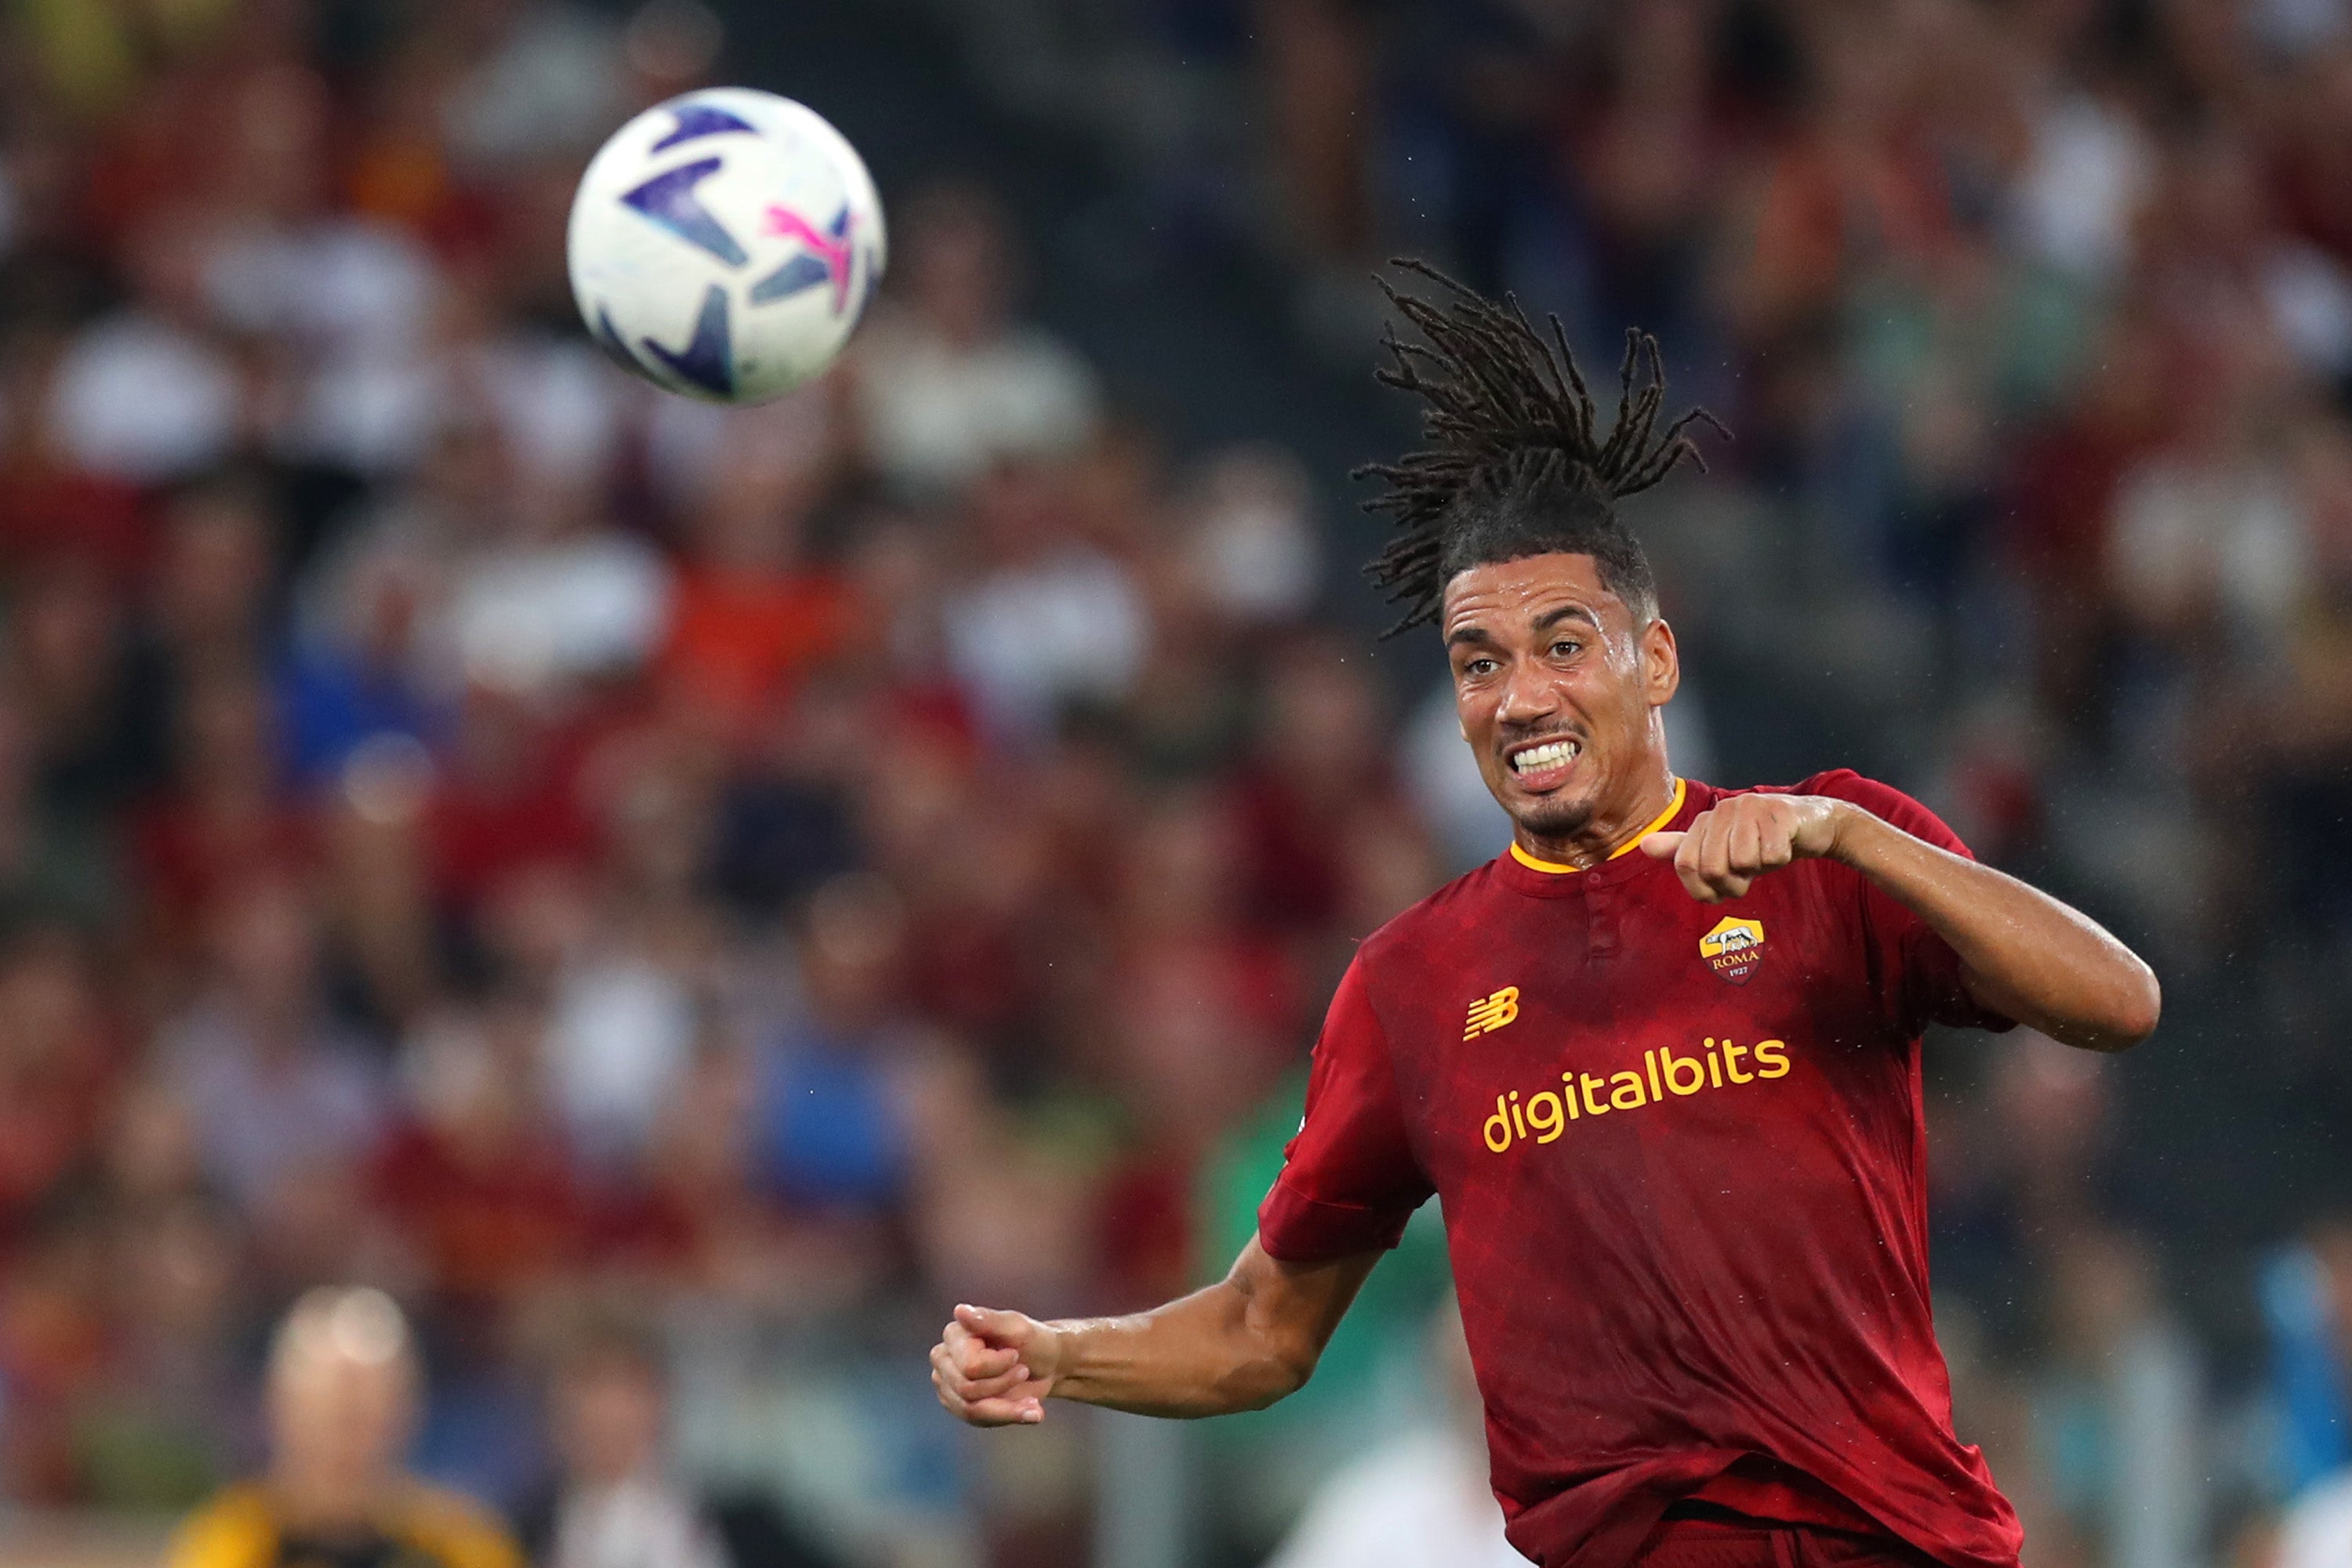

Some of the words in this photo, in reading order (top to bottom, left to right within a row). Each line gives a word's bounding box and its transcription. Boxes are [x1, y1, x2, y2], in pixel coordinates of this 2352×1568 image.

[1712, 950, 1760, 970] ROMA
[1729, 966, 1748, 977] 1927
[1483, 1036, 1791, 1154] digitalbits
